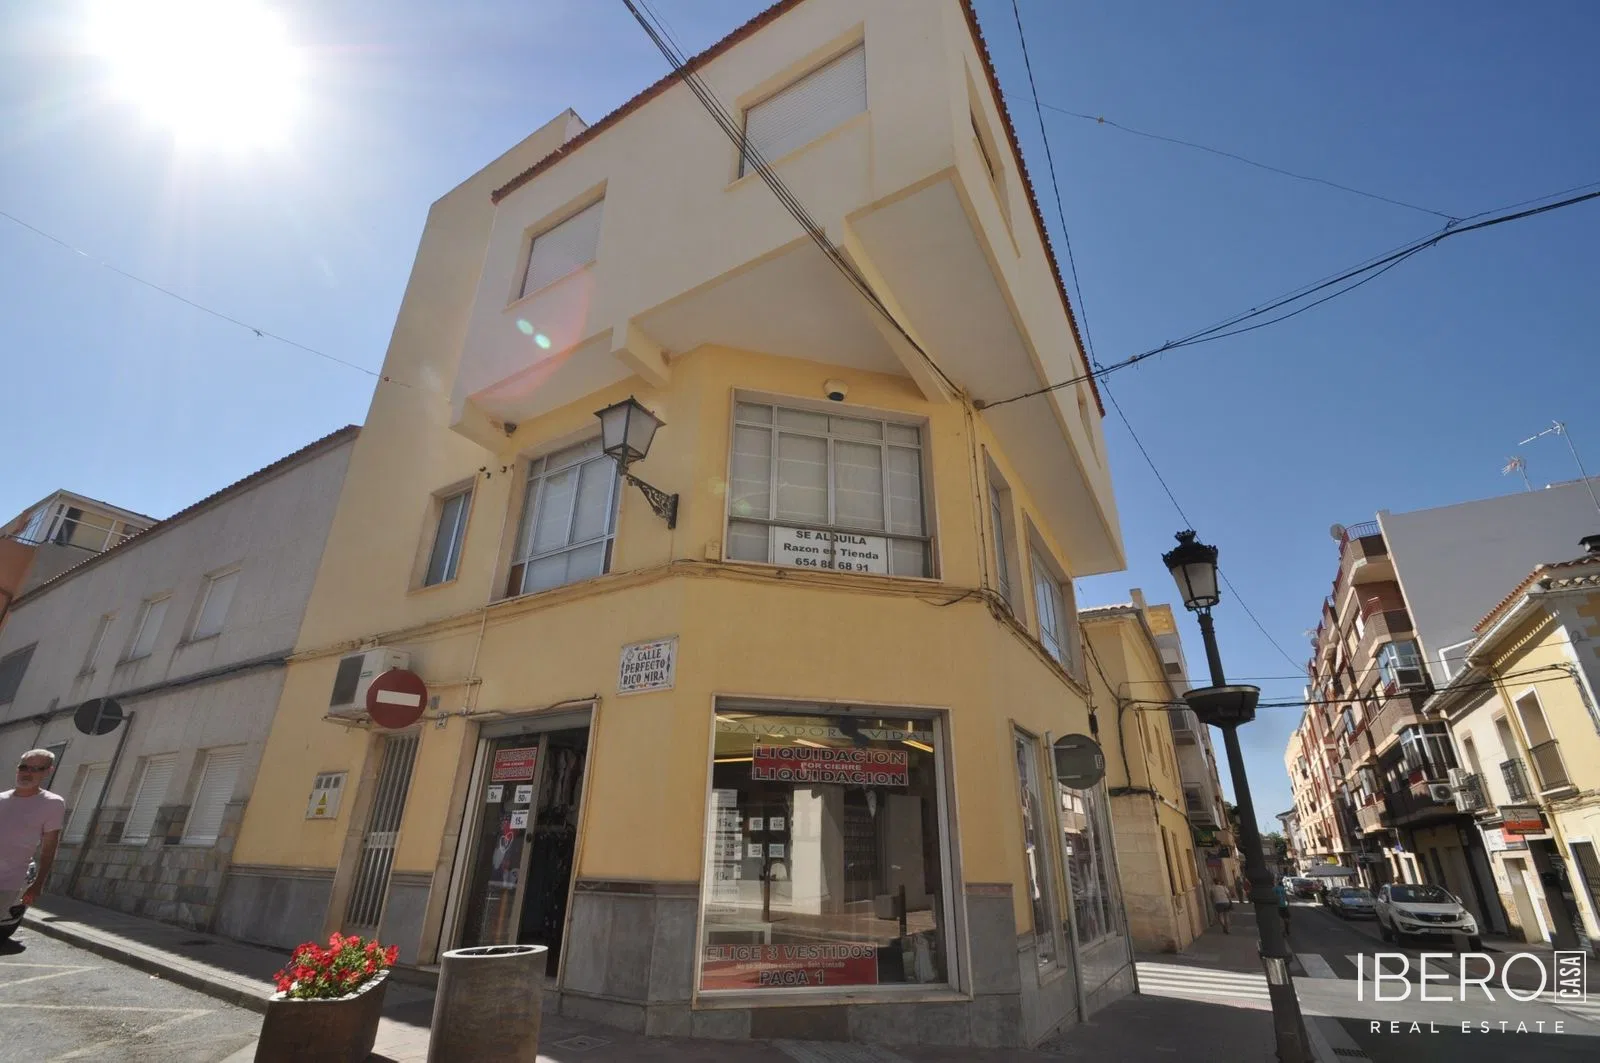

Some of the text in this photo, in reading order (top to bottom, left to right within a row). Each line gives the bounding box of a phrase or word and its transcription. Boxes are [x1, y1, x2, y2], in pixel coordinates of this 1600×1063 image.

[796, 530, 867, 545] SE ALQUILA
[783, 543, 819, 553] Razon
[840, 548, 879, 560] Tienda
[795, 557, 817, 567] 654
[838, 561, 852, 571] 68
[856, 563, 869, 572] 91
[637, 648, 661, 661] CALLE
[625, 658, 666, 674] PERFECTO
[623, 669, 664, 685] RICO MIRA
[720, 721, 837, 737] SALVADOR
[755, 745, 906, 765] LIQUIDACION
[800, 761, 862, 771] POR CIERRE
[754, 766, 906, 785] LIQUIDACION
[705, 944, 874, 961] ELIGE 3 VESTIDOS
[759, 969, 824, 985] PAGA 1
